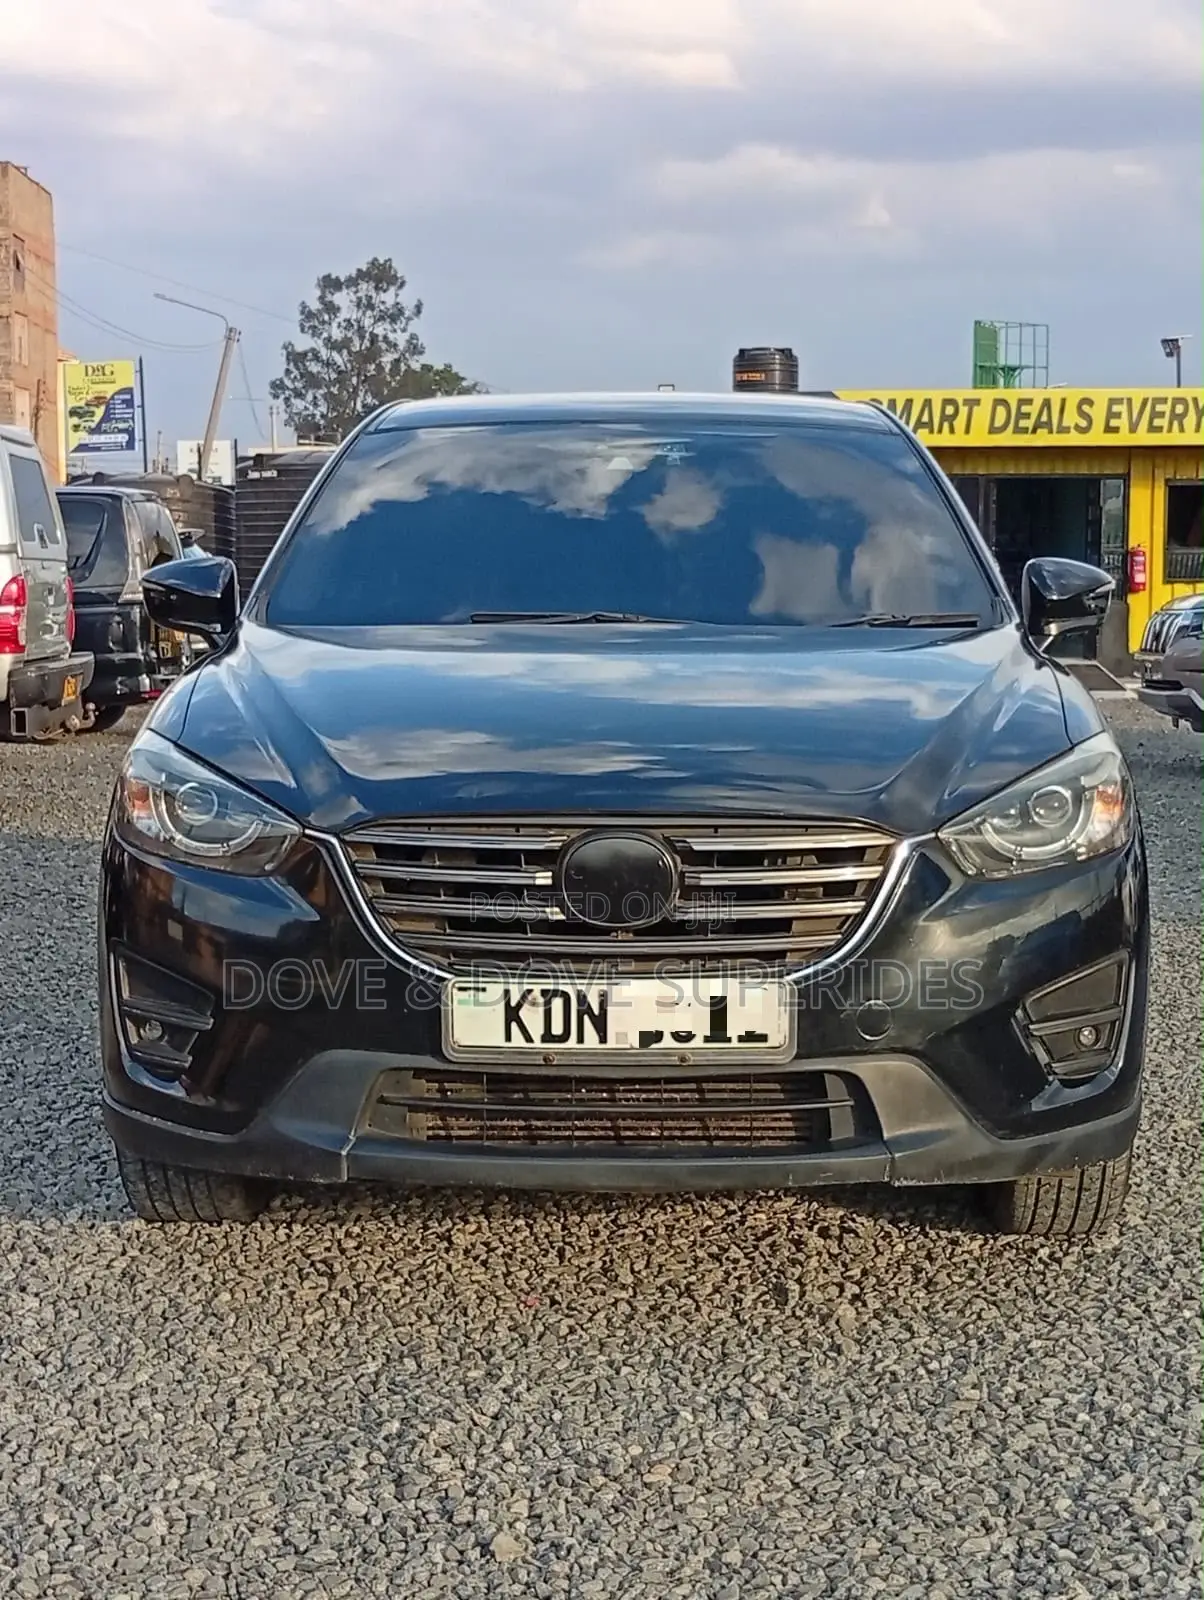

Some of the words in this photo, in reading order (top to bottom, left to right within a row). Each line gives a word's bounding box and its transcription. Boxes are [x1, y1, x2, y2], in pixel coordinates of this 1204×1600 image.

[868, 397, 980, 434] MART
[988, 397, 1095, 434] DEALS
[1103, 396, 1204, 434] EVERY
[504, 988, 609, 1044] KDN
